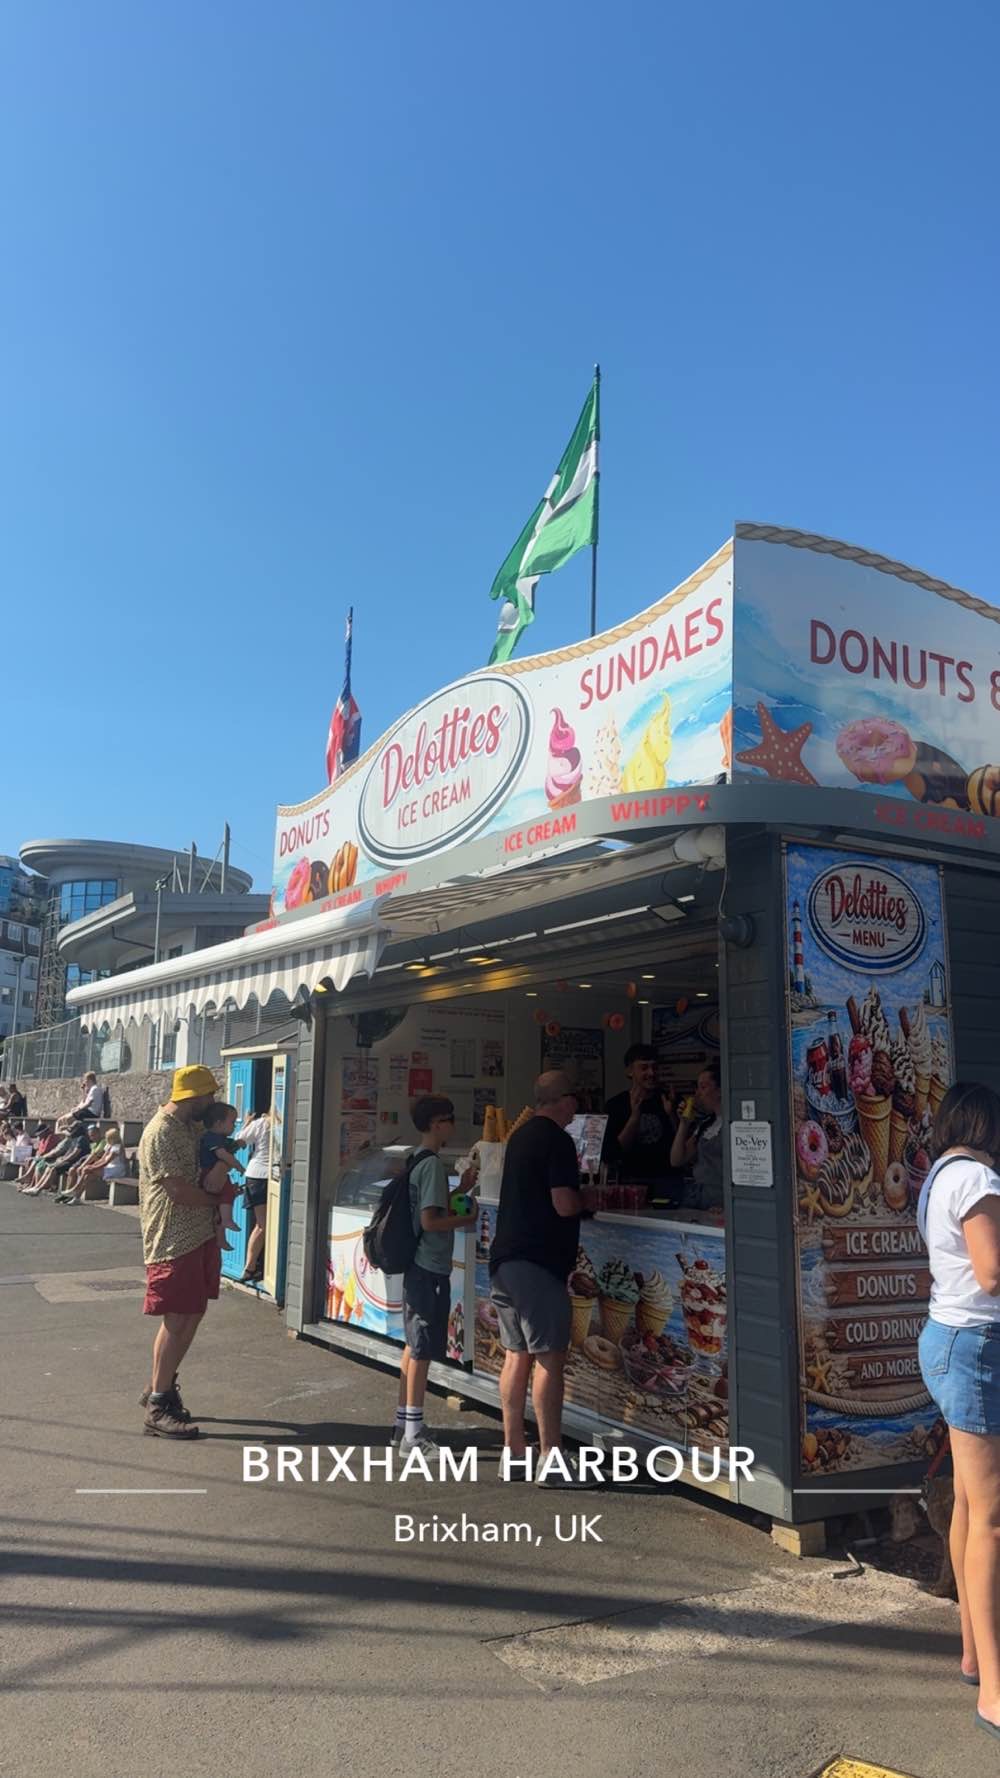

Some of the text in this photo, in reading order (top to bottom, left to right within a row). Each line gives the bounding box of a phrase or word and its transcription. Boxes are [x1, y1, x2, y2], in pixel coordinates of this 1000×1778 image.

[579, 598, 724, 710] SUNDAES
[810, 619, 975, 703] DONUTS
[380, 704, 506, 809] Delotties
[398, 776, 471, 831] ICE CREAM
[611, 793, 710, 822] WHIPPY
[279, 808, 330, 857] DONUTS
[504, 813, 576, 853] ICE CREAM
[913, 809, 986, 839] CREAM
[825, 874, 907, 931] Delotties
[852, 929, 885, 947] MENU
[846, 1230, 921, 1255] ICE CREAM
[857, 1274, 916, 1298] DONUTS
[846, 1322, 879, 1343] COLD
[861, 1362, 884, 1380] AND
